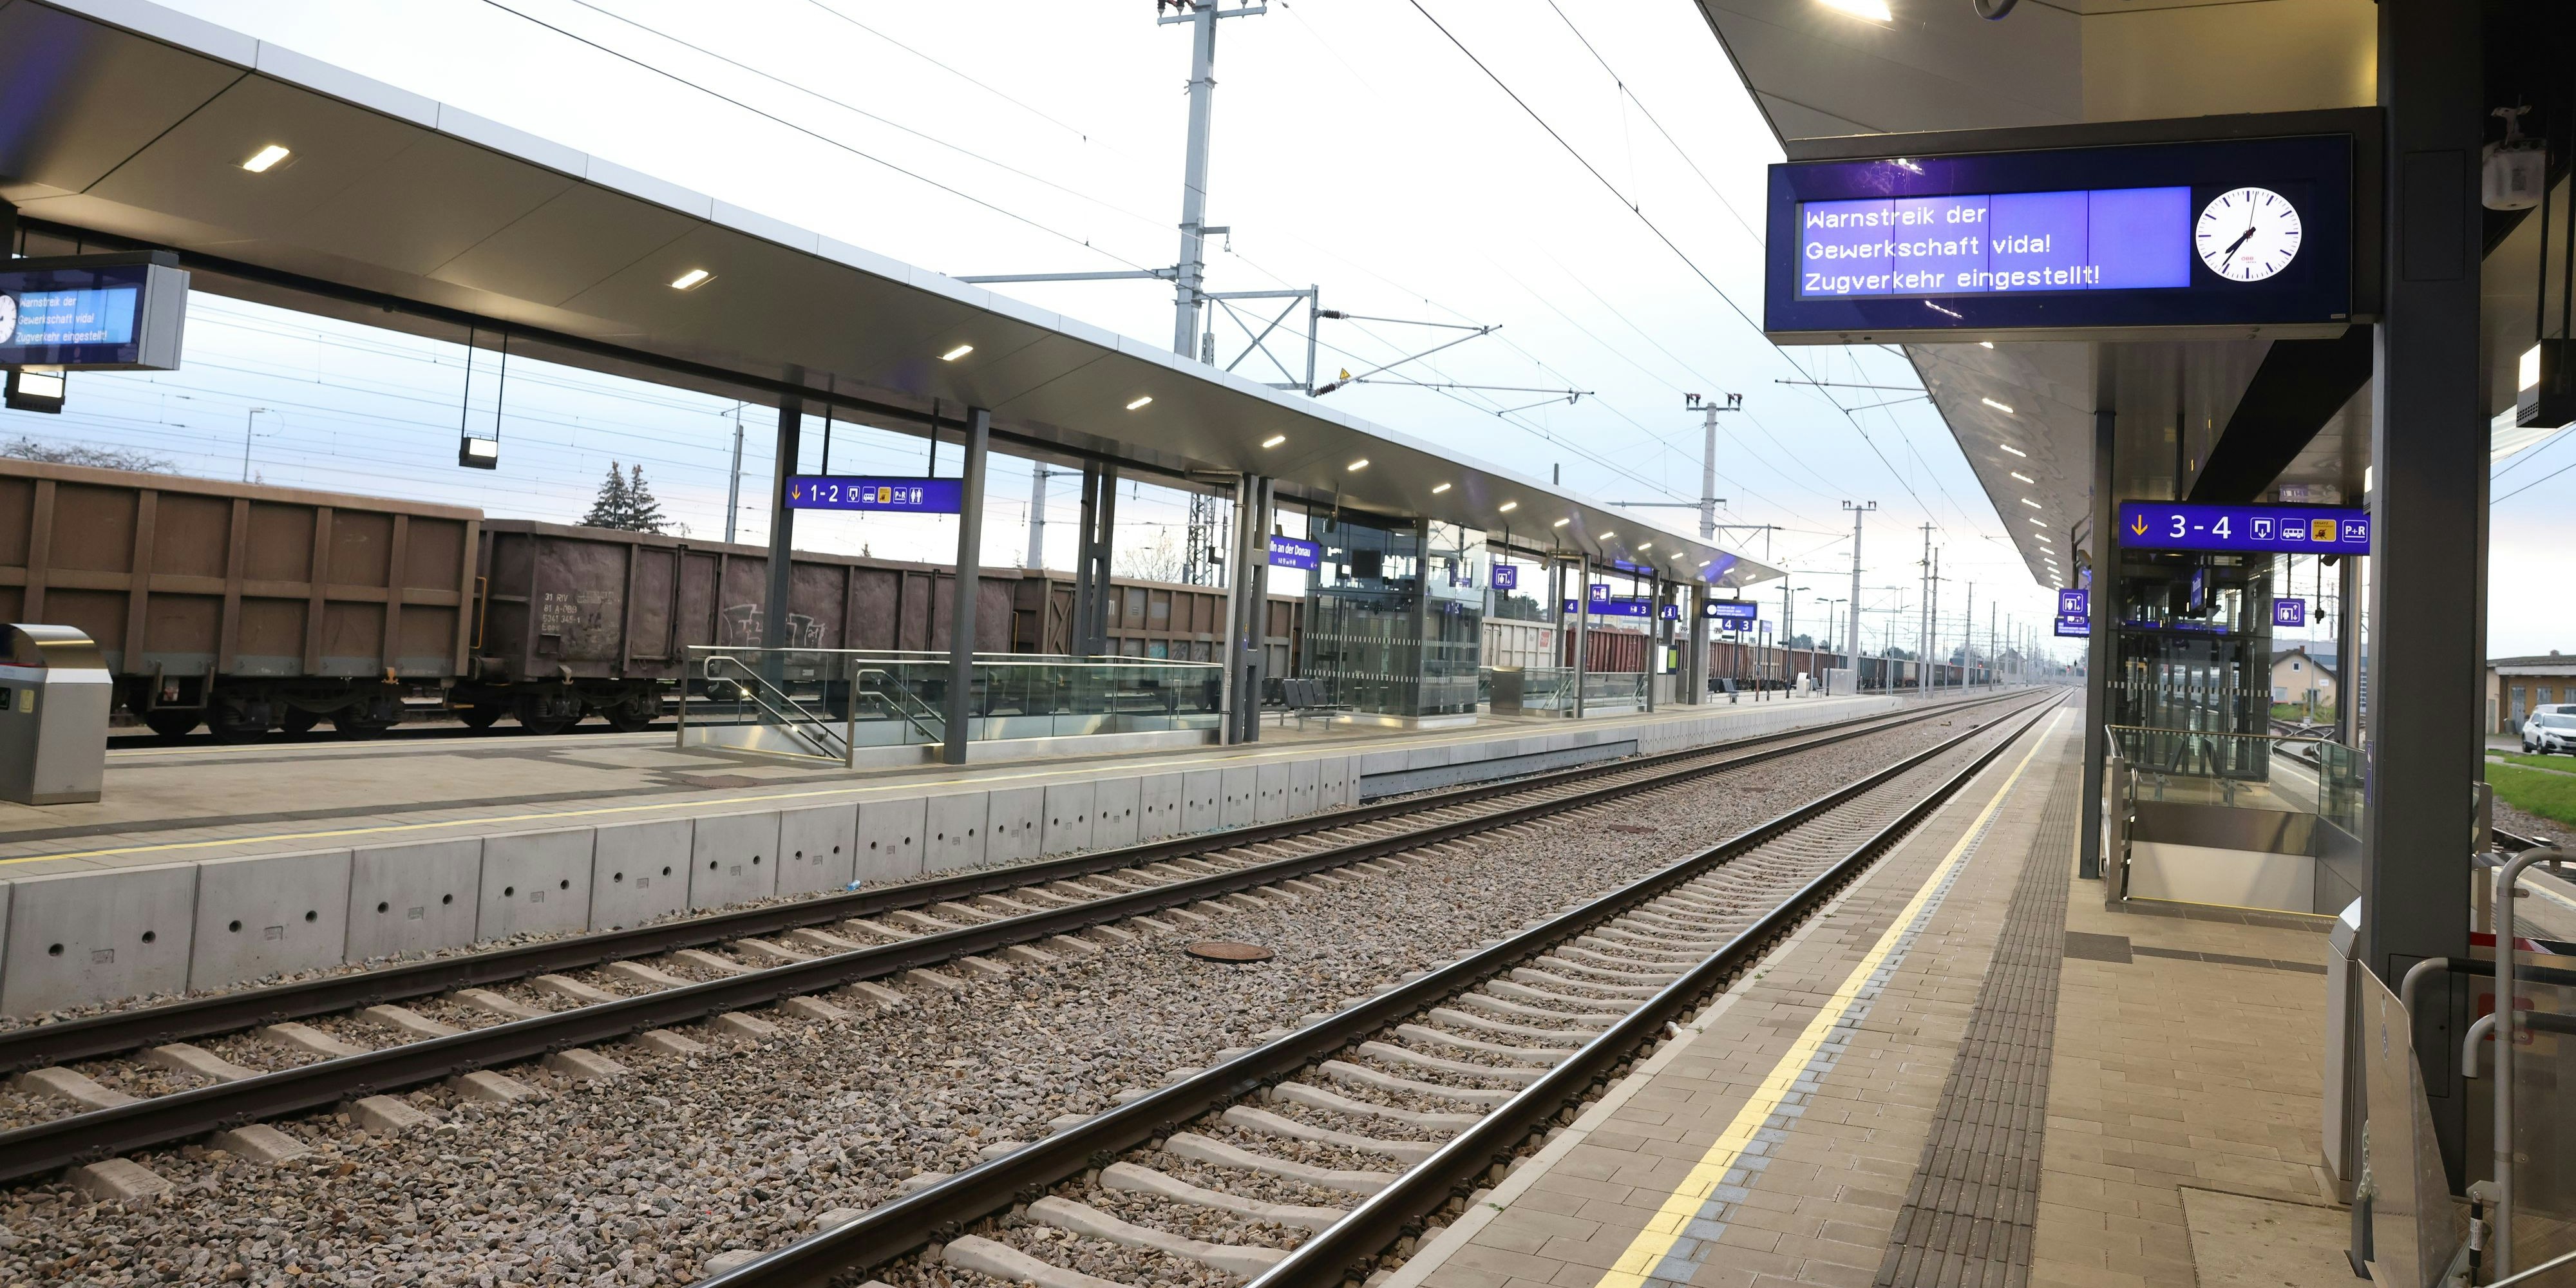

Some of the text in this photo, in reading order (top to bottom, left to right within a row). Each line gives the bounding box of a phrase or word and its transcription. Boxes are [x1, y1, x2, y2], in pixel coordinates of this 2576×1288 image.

[1806, 205, 1986, 229] Warnstreik der
[1806, 234, 2050, 260] Gewerkschaft vida!
[1805, 265, 2100, 294] Zugverkehr eingestellt!
[19, 296, 77, 308] Warnstreik der
[17, 313, 95, 325] Gewerkschaft vida!
[15, 332, 61, 344] Zugverkehr
[2345, 526, 2365, 536] P+R
[1277, 544, 1285, 553] an
[1285, 543, 1294, 554] der
[1294, 545, 1311, 557] Donau
[556, 593, 568, 601] RIV
[1725, 620, 1732, 629] 4
[1743, 620, 1749, 630] 3
